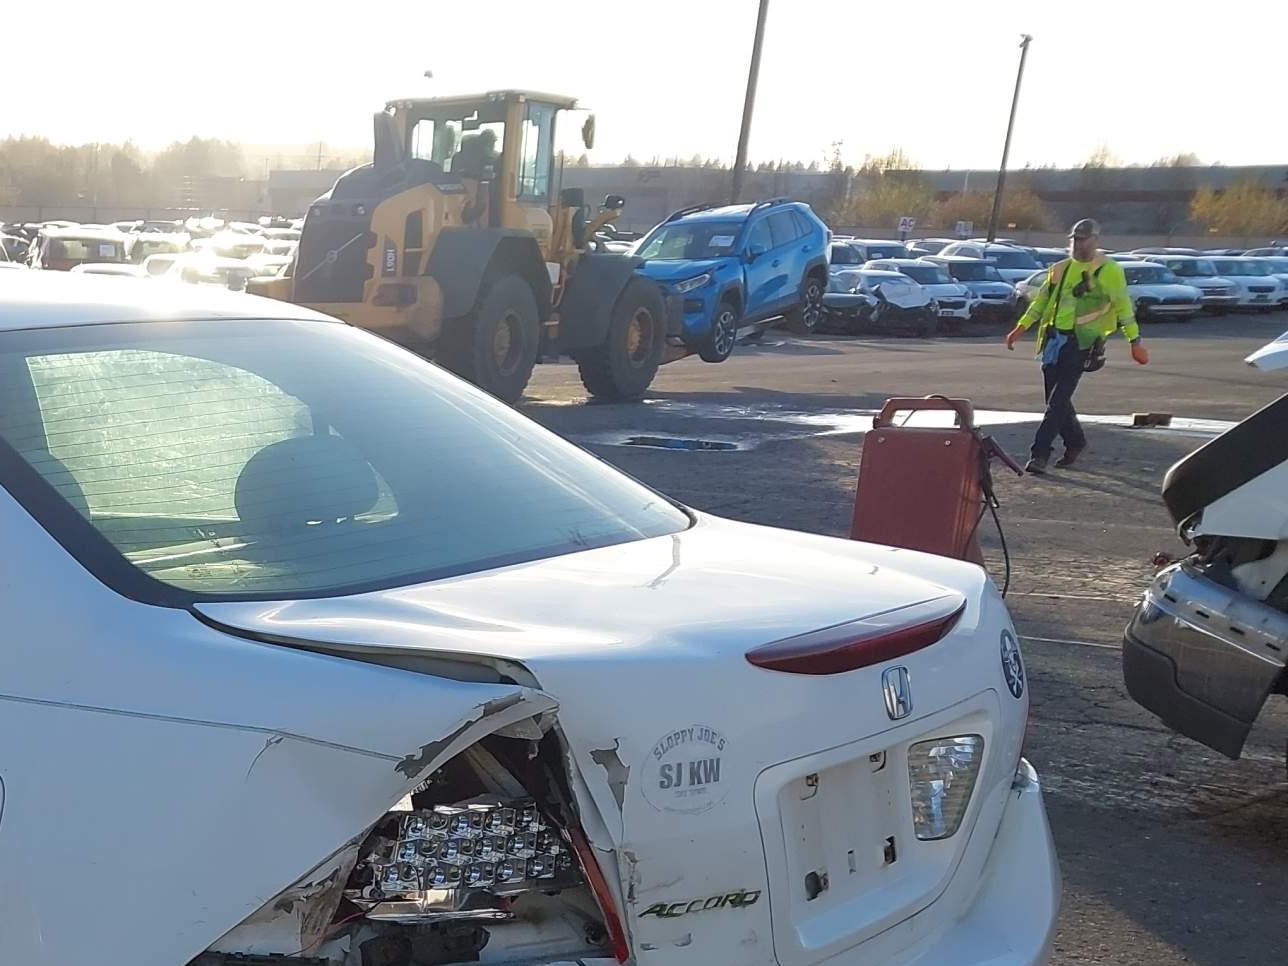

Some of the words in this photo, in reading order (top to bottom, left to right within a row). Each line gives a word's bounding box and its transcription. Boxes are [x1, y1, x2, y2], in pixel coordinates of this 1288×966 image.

[653, 727, 694, 761] SLOPPY
[658, 762, 683, 789] SJ
[689, 757, 721, 786] KW
[637, 889, 762, 918] ACCORD
